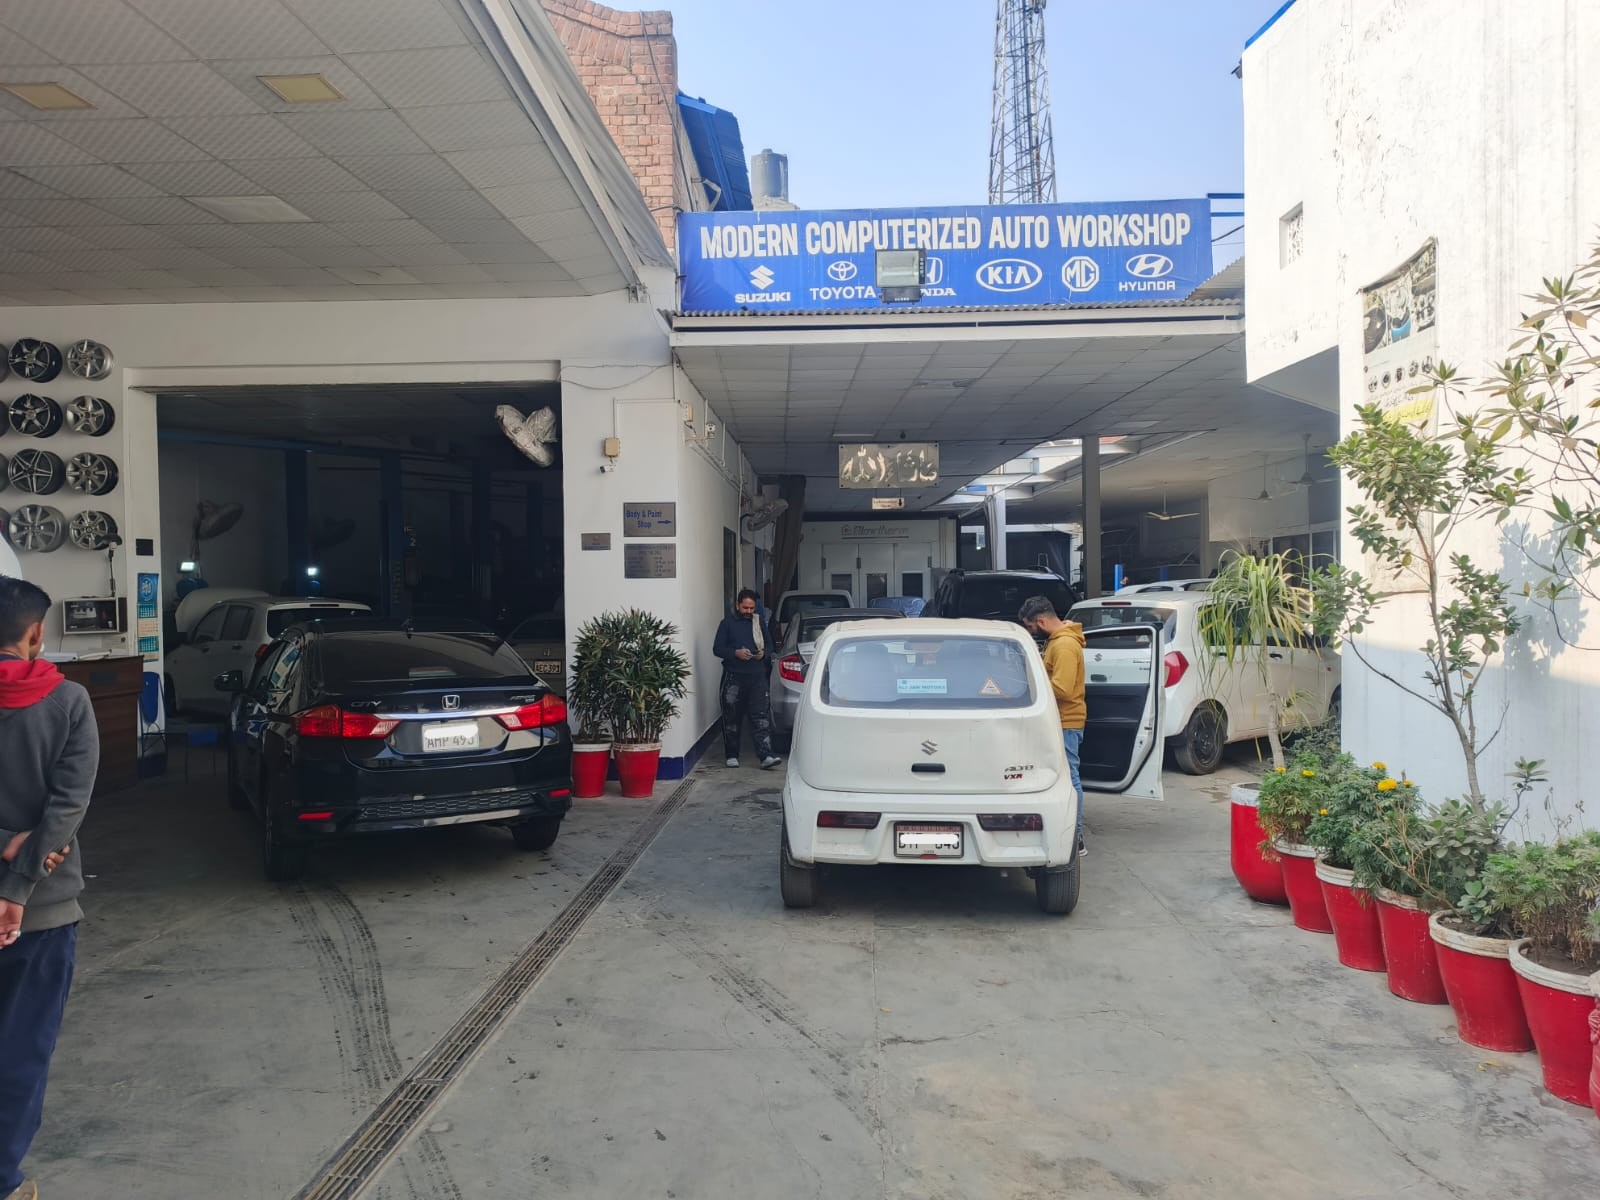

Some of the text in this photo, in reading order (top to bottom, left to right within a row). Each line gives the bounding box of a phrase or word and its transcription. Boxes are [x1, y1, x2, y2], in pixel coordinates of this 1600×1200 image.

[700, 212, 1191, 259] MODERN COMPUTERIZED AUTO WORKSHOP
[987, 265, 1032, 285] KIA
[1066, 260, 1096, 288] MG
[734, 291, 791, 303] SUZUKI
[809, 285, 877, 300] TOYOTA
[920, 287, 957, 297] NDA
